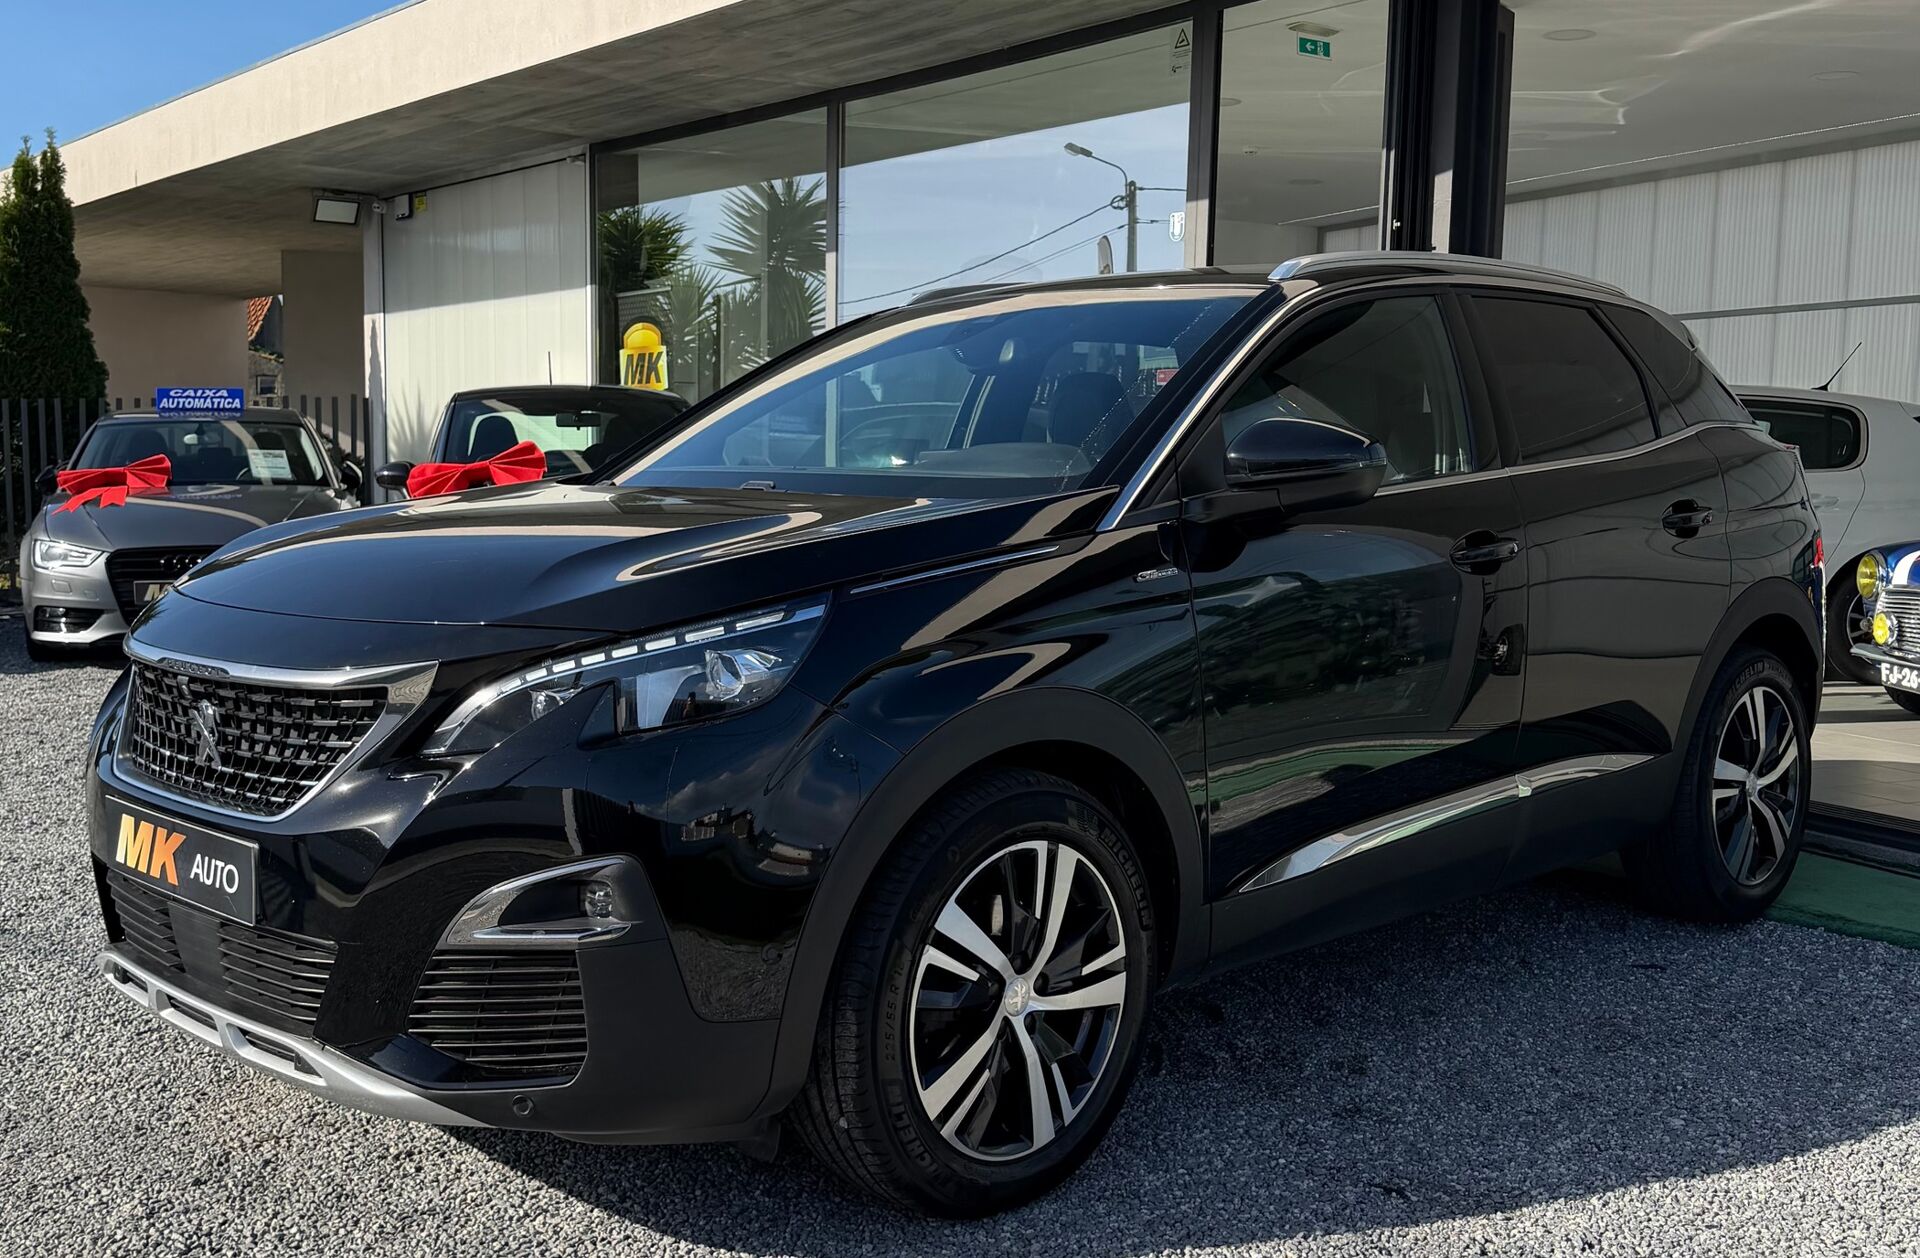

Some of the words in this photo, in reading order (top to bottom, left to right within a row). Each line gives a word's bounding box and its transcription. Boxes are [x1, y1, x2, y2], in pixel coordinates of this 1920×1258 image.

[624, 351, 663, 385] MK
[159, 396, 241, 409] AUTOMÁTICA
[169, 389, 229, 397] CAIXA
[115, 813, 188, 887] MK
[190, 853, 240, 894] AUTO
[1101, 827, 1153, 930] MICHELIN
